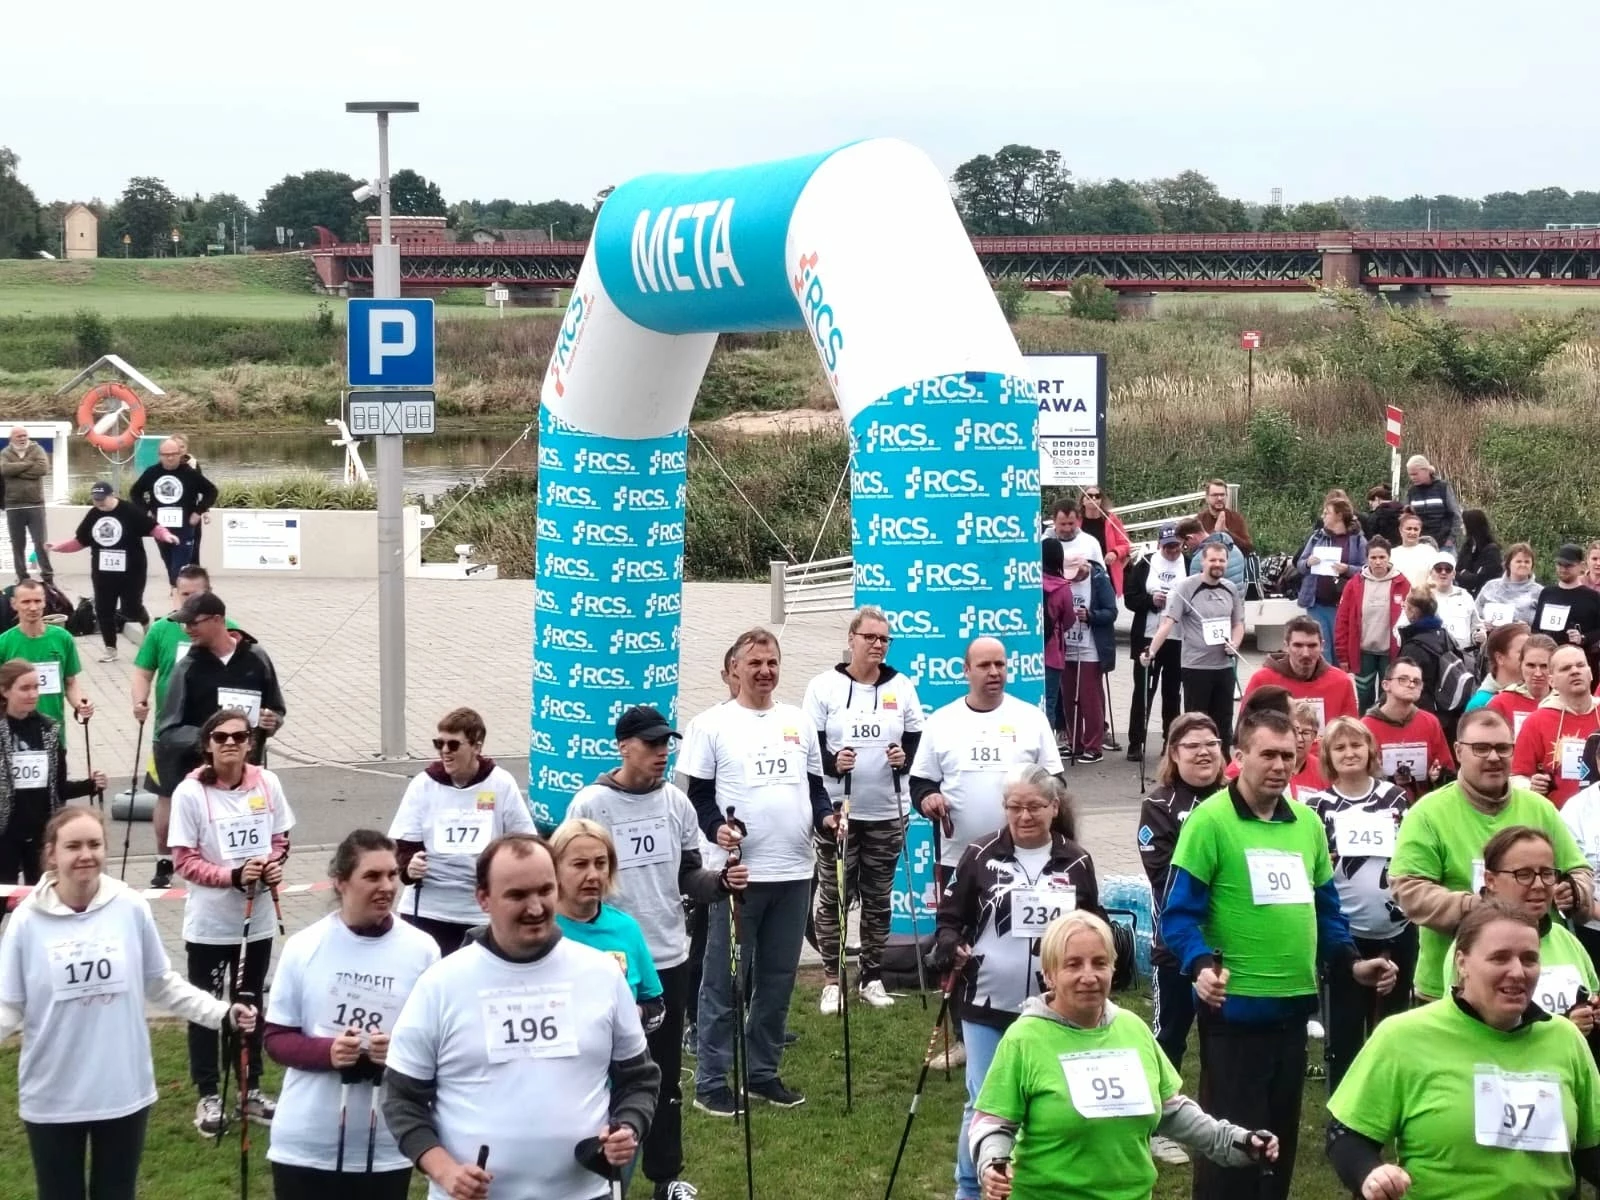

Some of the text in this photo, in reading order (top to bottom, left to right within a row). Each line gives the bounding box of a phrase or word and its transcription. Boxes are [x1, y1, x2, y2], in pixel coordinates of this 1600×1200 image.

[631, 197, 745, 293] META
[369, 309, 416, 375] P
[922, 376, 984, 400] RCS.
[1038, 379, 1065, 394] RT
[1039, 398, 1088, 412] AWA
[880, 423, 936, 447] RCS.
[974, 421, 1024, 445] RCS.
[588, 452, 636, 471] RCS.
[923, 469, 985, 493] RCS.
[555, 487, 598, 506] RCS.
[628, 489, 670, 507] RCS.
[587, 524, 634, 543] RCS.
[881, 516, 937, 540] RCS.
[976, 515, 1025, 539] RCS.
[552, 557, 595, 577] RCS.
[626, 560, 668, 578] RCS.
[926, 562, 987, 586] RCS.
[584, 596, 633, 615] RCS.
[978, 607, 1028, 632] RCS.
[1549, 615, 1562, 626] 81
[551, 628, 594, 649] RCS.
[625, 631, 666, 650] RCS.
[583, 667, 631, 686] RCS.
[550, 699, 592, 720] RCS.
[851, 724, 881, 738] 180
[970, 747, 1002, 762] 181
[12, 766, 41, 779] 206
[755, 758, 788, 776] 179
[227, 828, 260, 848] 176
[445, 827, 480, 843] 177
[629, 834, 655, 855] 70
[1347, 829, 1384, 846] 245
[1267, 871, 1291, 891] 90
[1022, 905, 1062, 925] 234
[64, 957, 112, 985] 170
[1541, 991, 1570, 1014] 94
[332, 1002, 383, 1034] 188
[502, 1014, 559, 1044] 196
[1091, 1076, 1125, 1101] 95
[1503, 1102, 1536, 1131] 97
